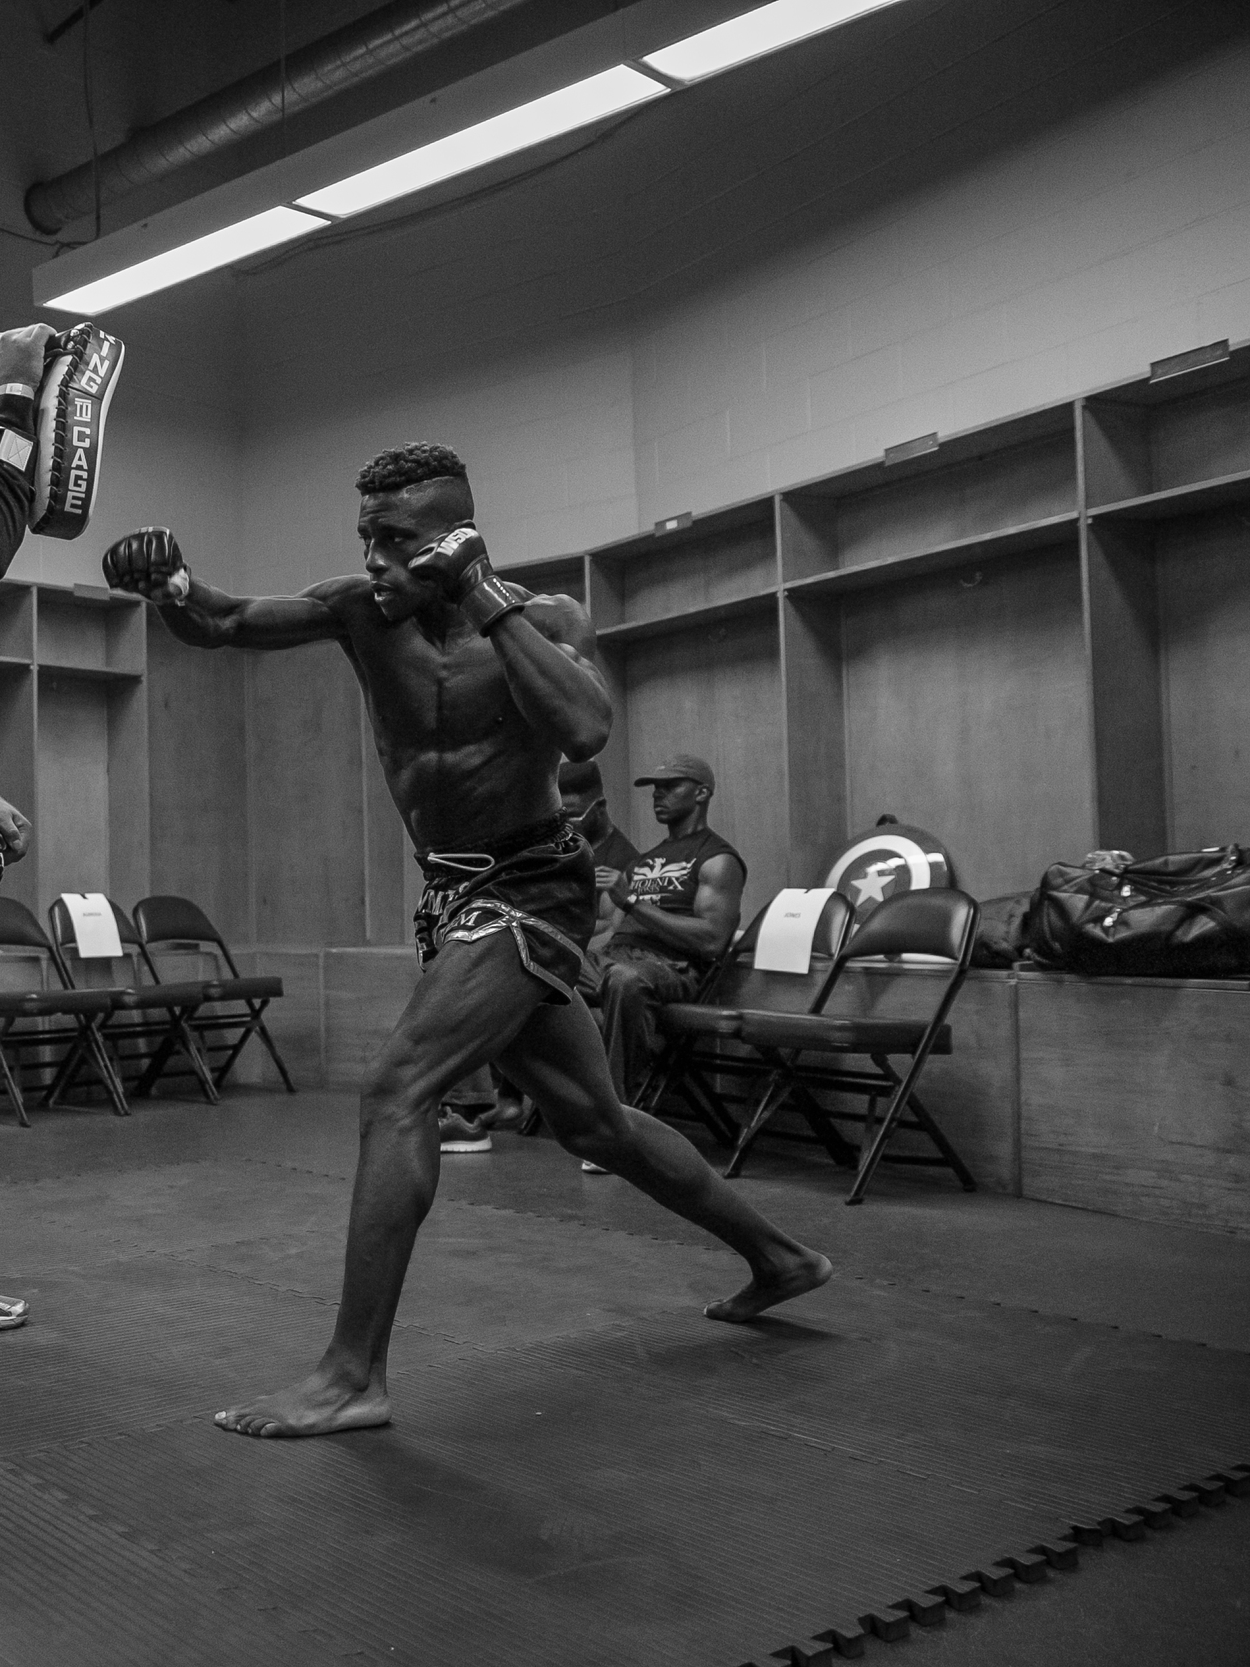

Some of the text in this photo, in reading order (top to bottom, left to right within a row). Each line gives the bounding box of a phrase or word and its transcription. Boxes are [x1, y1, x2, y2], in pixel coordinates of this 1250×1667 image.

[73, 397, 92, 422] TO
[64, 426, 91, 514] CAGE
[630, 876, 688, 891] HOENIX
